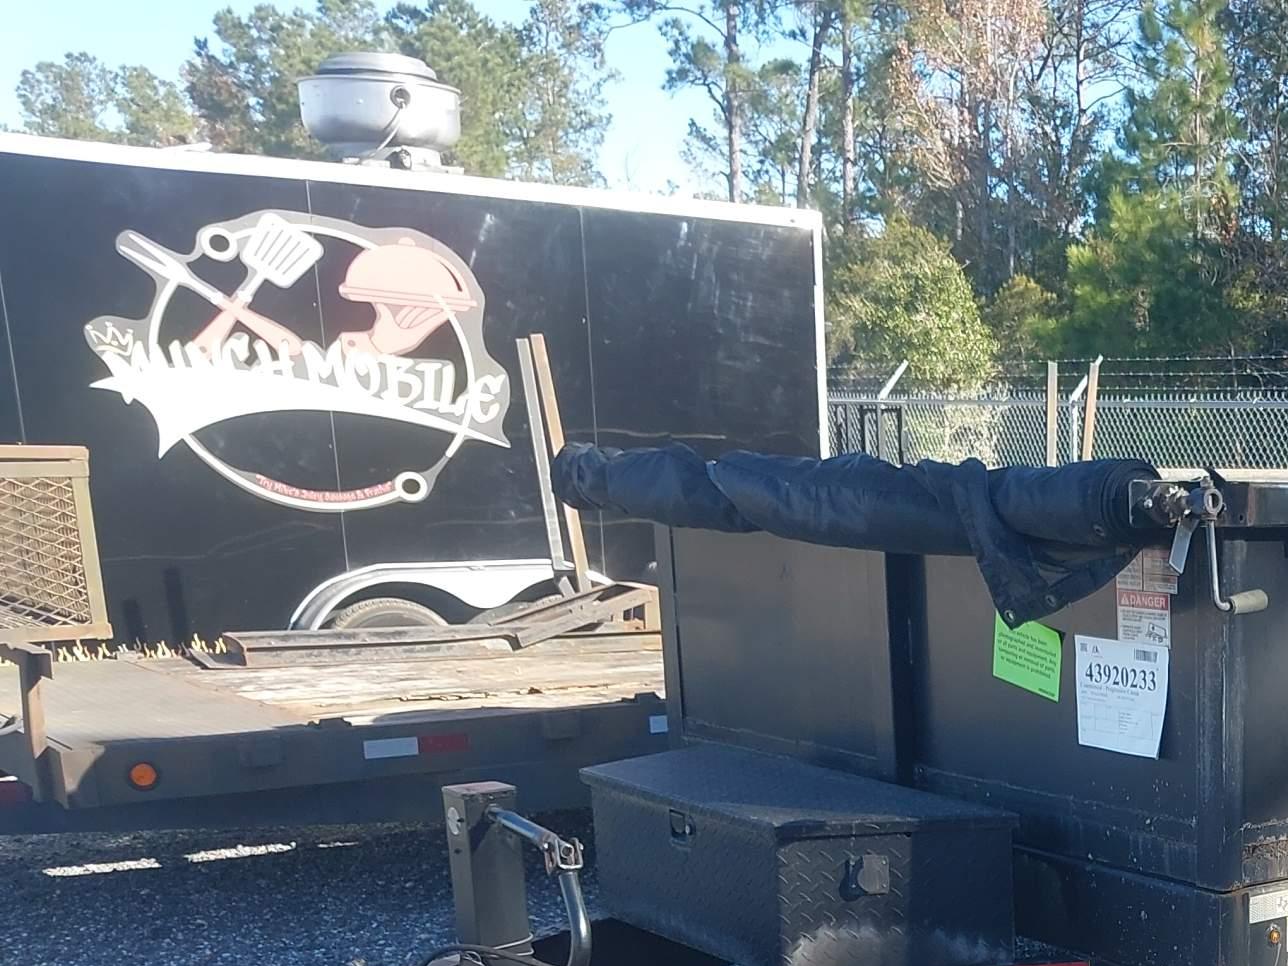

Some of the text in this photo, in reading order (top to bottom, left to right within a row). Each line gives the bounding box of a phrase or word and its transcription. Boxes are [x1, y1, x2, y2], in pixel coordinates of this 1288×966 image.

[302, 340, 506, 423] MOBILE
[1129, 593, 1166, 608] DANGER
[1085, 662, 1156, 692] 43920233
